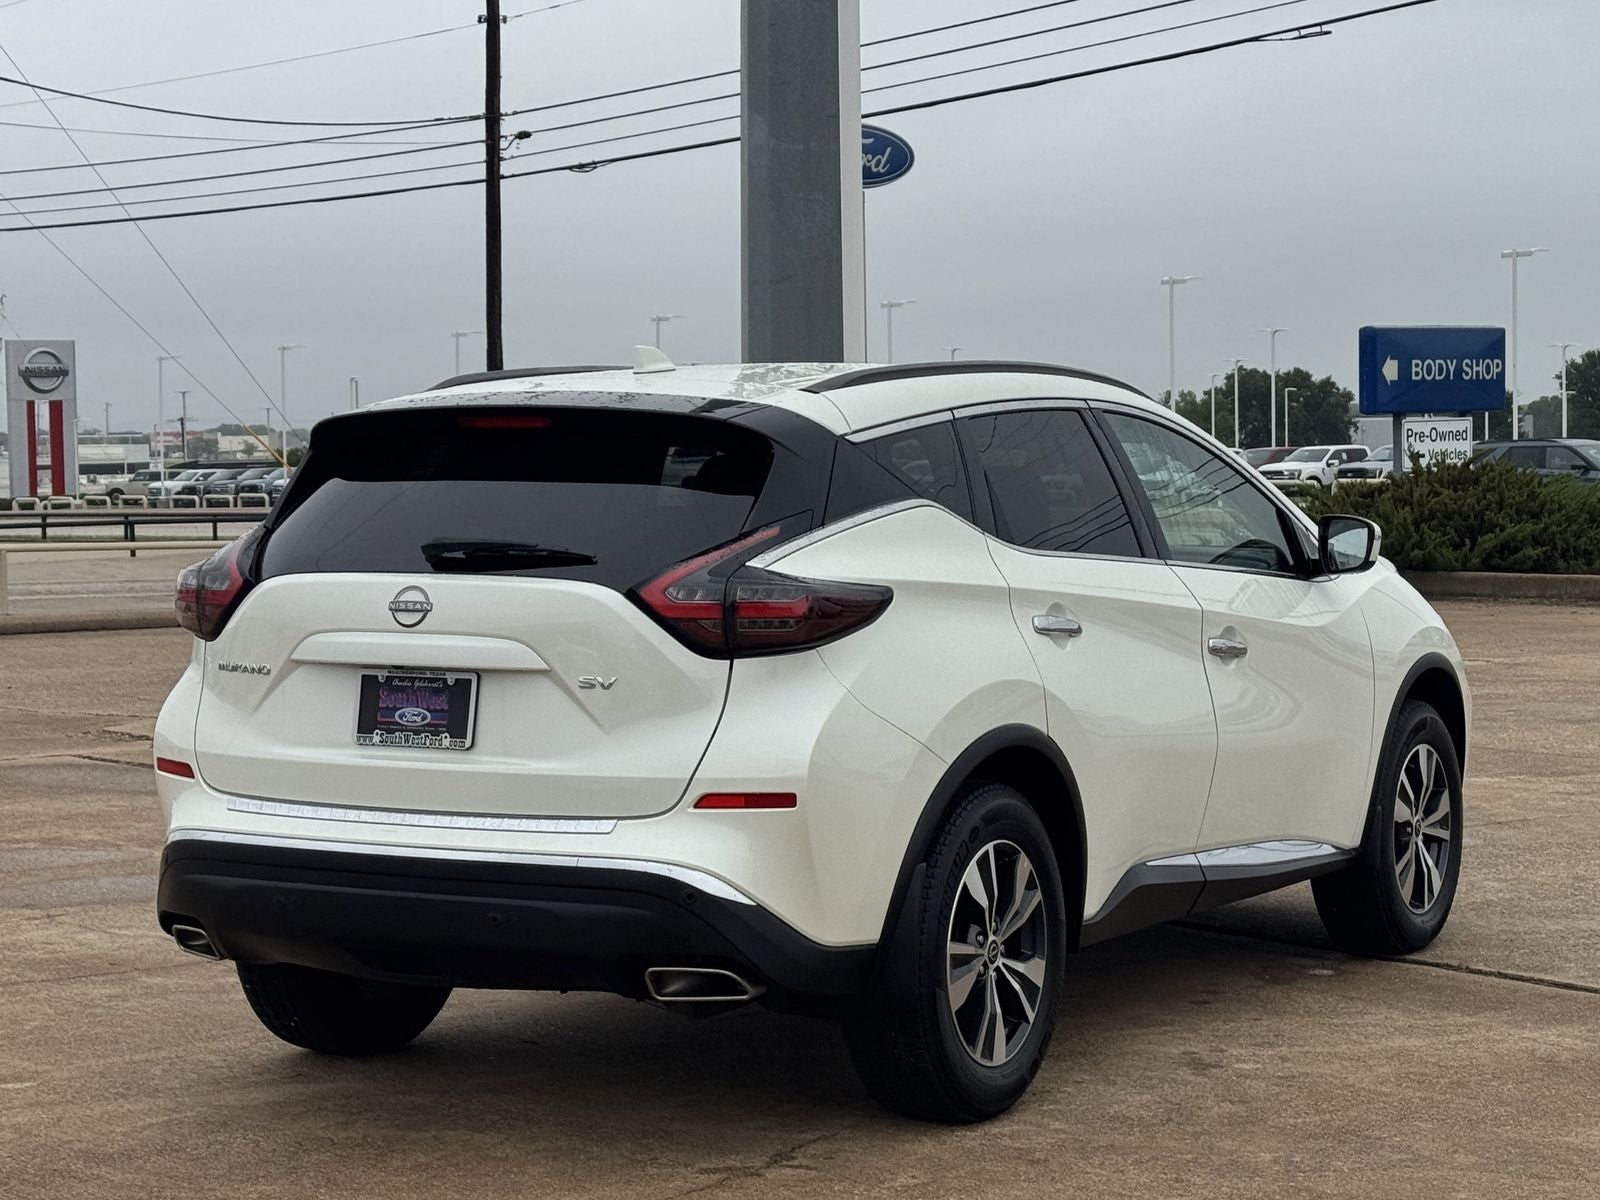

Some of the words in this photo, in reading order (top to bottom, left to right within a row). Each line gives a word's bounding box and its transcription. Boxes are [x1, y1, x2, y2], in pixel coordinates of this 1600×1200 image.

[25, 366, 64, 374] NISSAN
[1411, 359, 1457, 380] BODY
[1462, 359, 1502, 380] SHOP
[1406, 426, 1468, 443] Pre-Owned
[1428, 448, 1468, 461] Vehicles
[390, 602, 431, 610] NISSAN
[578, 676, 617, 690] SV
[402, 711, 423, 722] Ford
